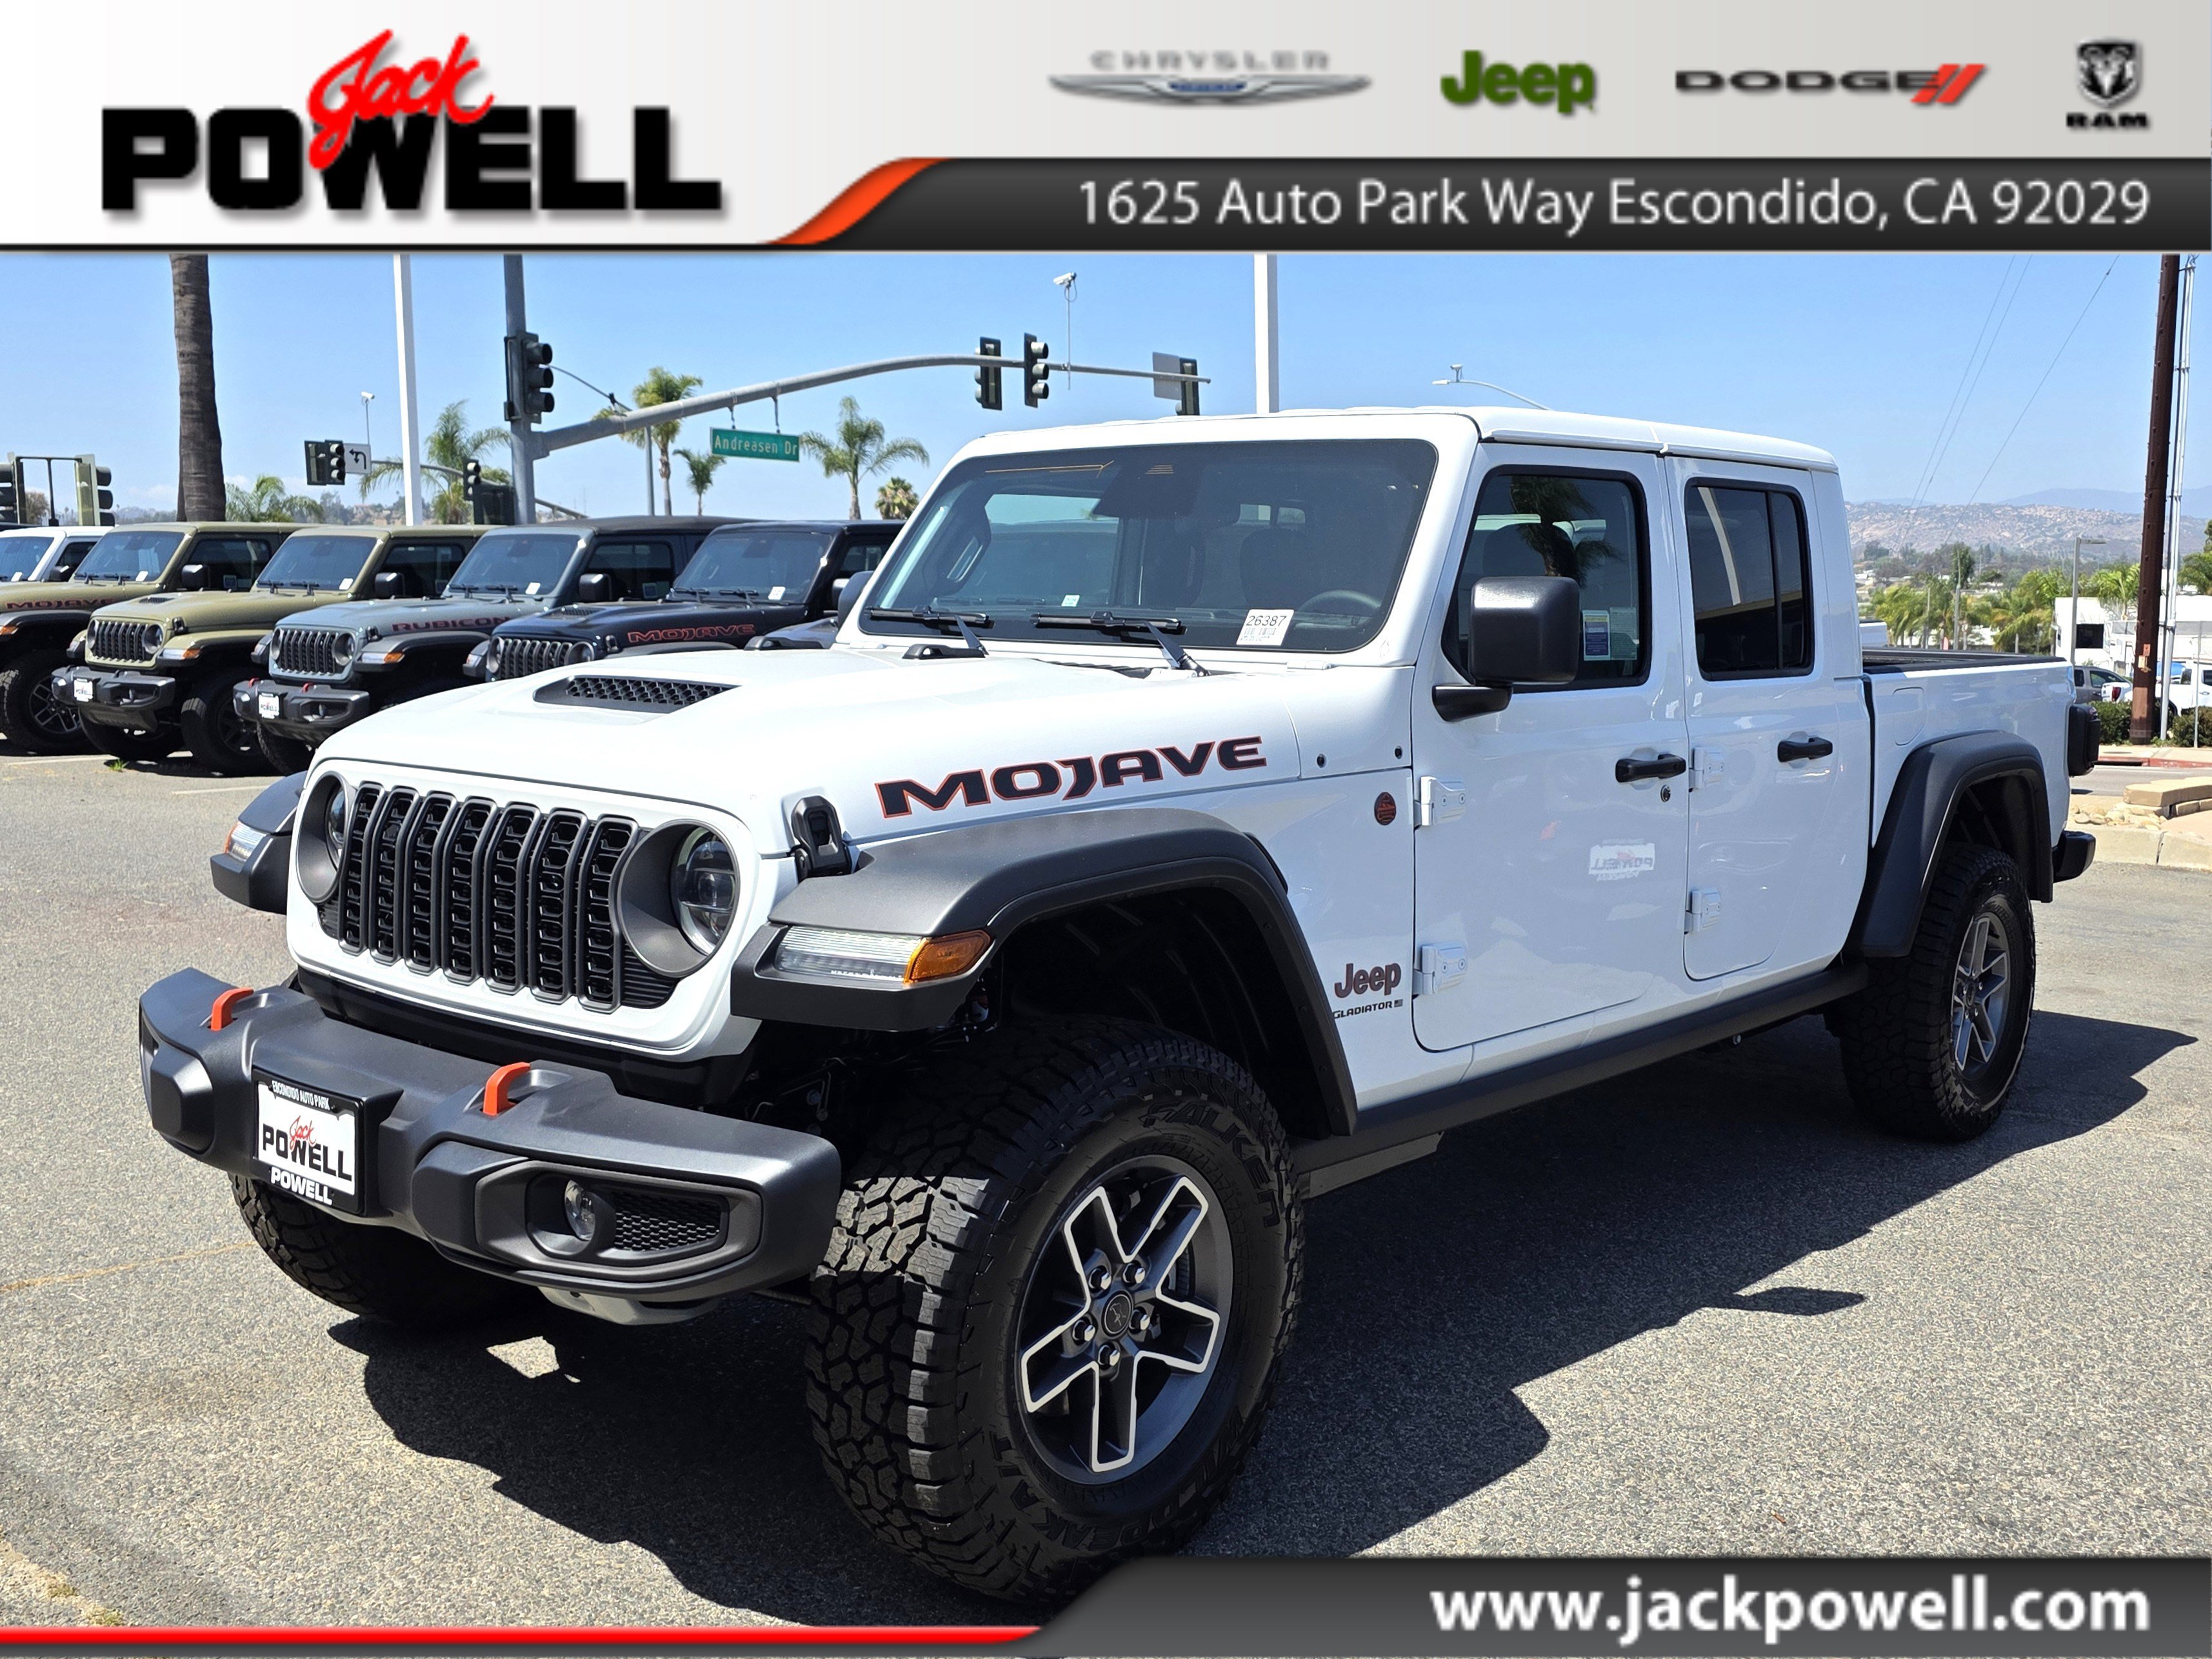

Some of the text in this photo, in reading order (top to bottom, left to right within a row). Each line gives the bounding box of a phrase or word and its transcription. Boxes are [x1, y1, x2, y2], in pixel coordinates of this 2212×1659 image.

[714, 435, 798, 455] Andreasen Dr
[6, 598, 118, 609] MOJAVE
[1246, 615, 1287, 627] 26387
[628, 624, 755, 643] MOJAVE
[874, 735, 1268, 818] MOJAVE
[1334, 963, 1402, 998] Jeep
[1332, 1001, 1393, 1019] GLADIATOR
[299, 1090, 314, 1106] AUTO
[314, 1094, 330, 1111] PARK
[289, 1115, 317, 1150] Jack
[263, 1123, 352, 1181] POWELL
[271, 1166, 333, 1205] POWELL
